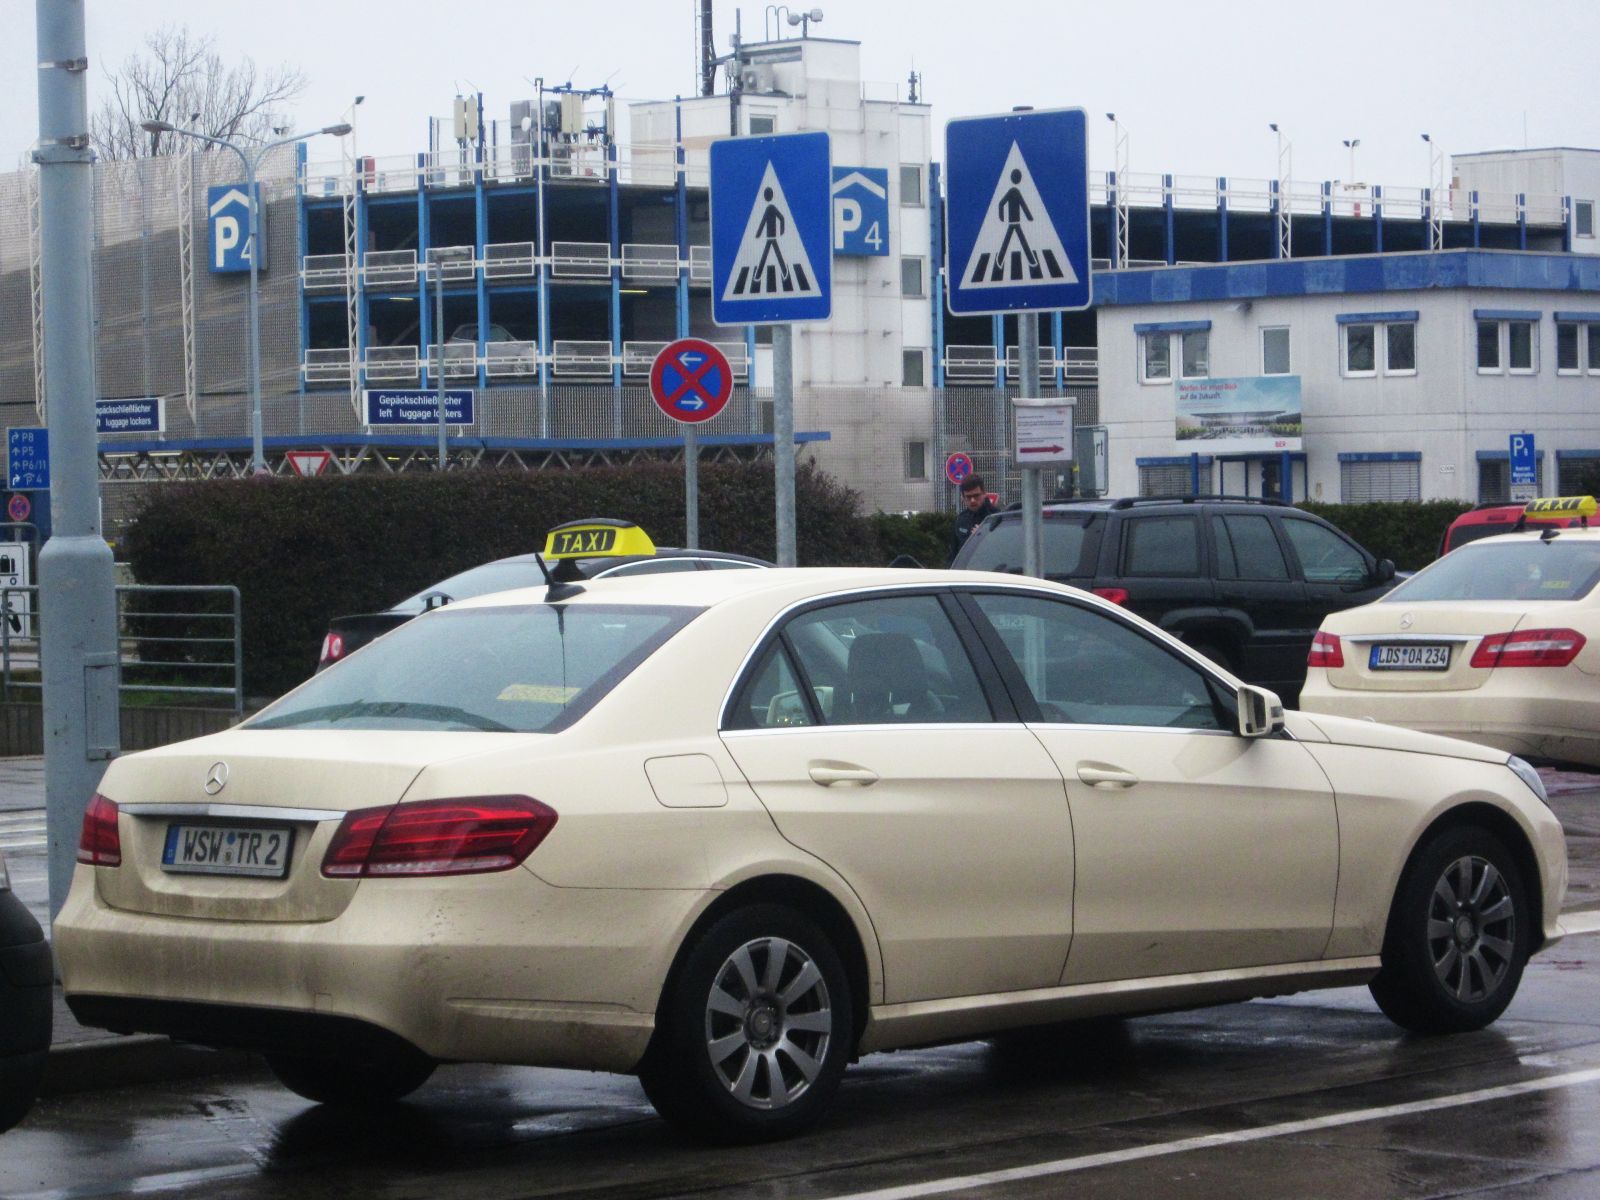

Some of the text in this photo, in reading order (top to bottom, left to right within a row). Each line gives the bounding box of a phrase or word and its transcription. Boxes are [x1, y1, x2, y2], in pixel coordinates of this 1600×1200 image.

[835, 197, 883, 252] P 4
[215, 216, 239, 267] P
[105, 418, 129, 428] luggage
[130, 416, 152, 425] lockers
[379, 408, 462, 419] left luggage lokers
[1513, 437, 1525, 457] P
[1533, 499, 1577, 512] TAXI
[562, 531, 608, 553] TAXI
[1379, 648, 1446, 664] LDS OA 234
[183, 830, 281, 866] WSW TR 2
